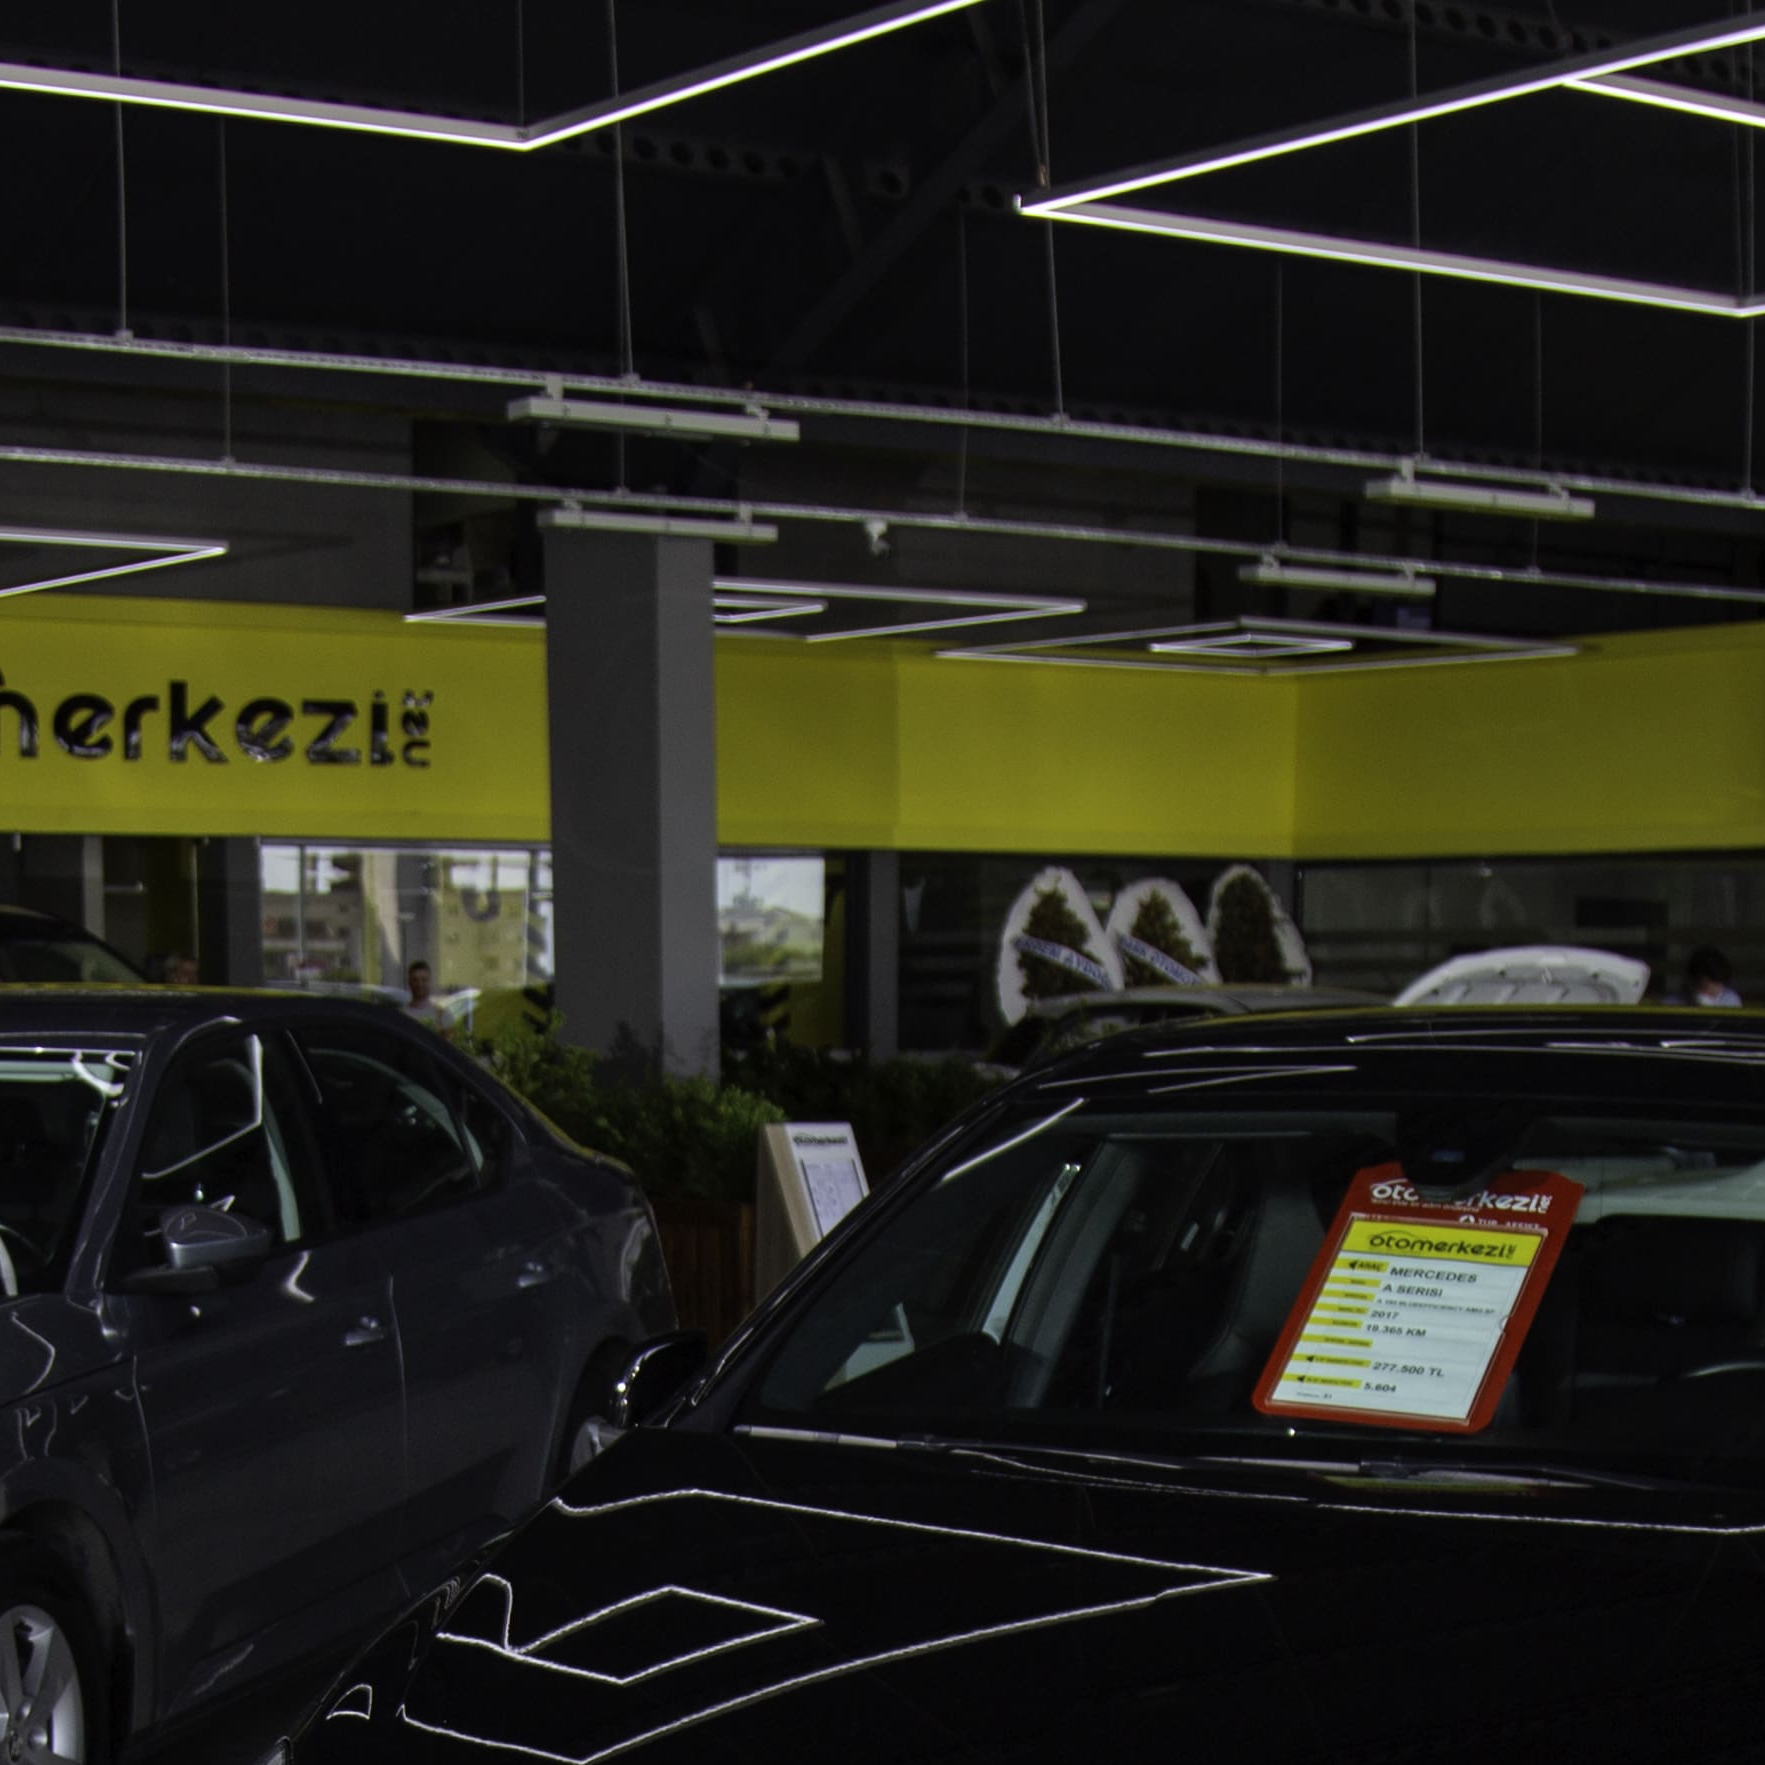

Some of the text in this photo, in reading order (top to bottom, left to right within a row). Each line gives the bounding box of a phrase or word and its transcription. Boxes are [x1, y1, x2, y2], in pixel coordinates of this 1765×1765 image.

[1369, 1234, 1506, 1259] otomerkezi
[1390, 1266, 1478, 1284] MERCEDES
[1383, 1284, 1394, 1293] A
[1371, 1310, 1400, 1320] 2017
[1406, 1328, 1427, 1337] KM
[1372, 1361, 1425, 1375] 277.500
[1429, 1367, 1445, 1377] TL
